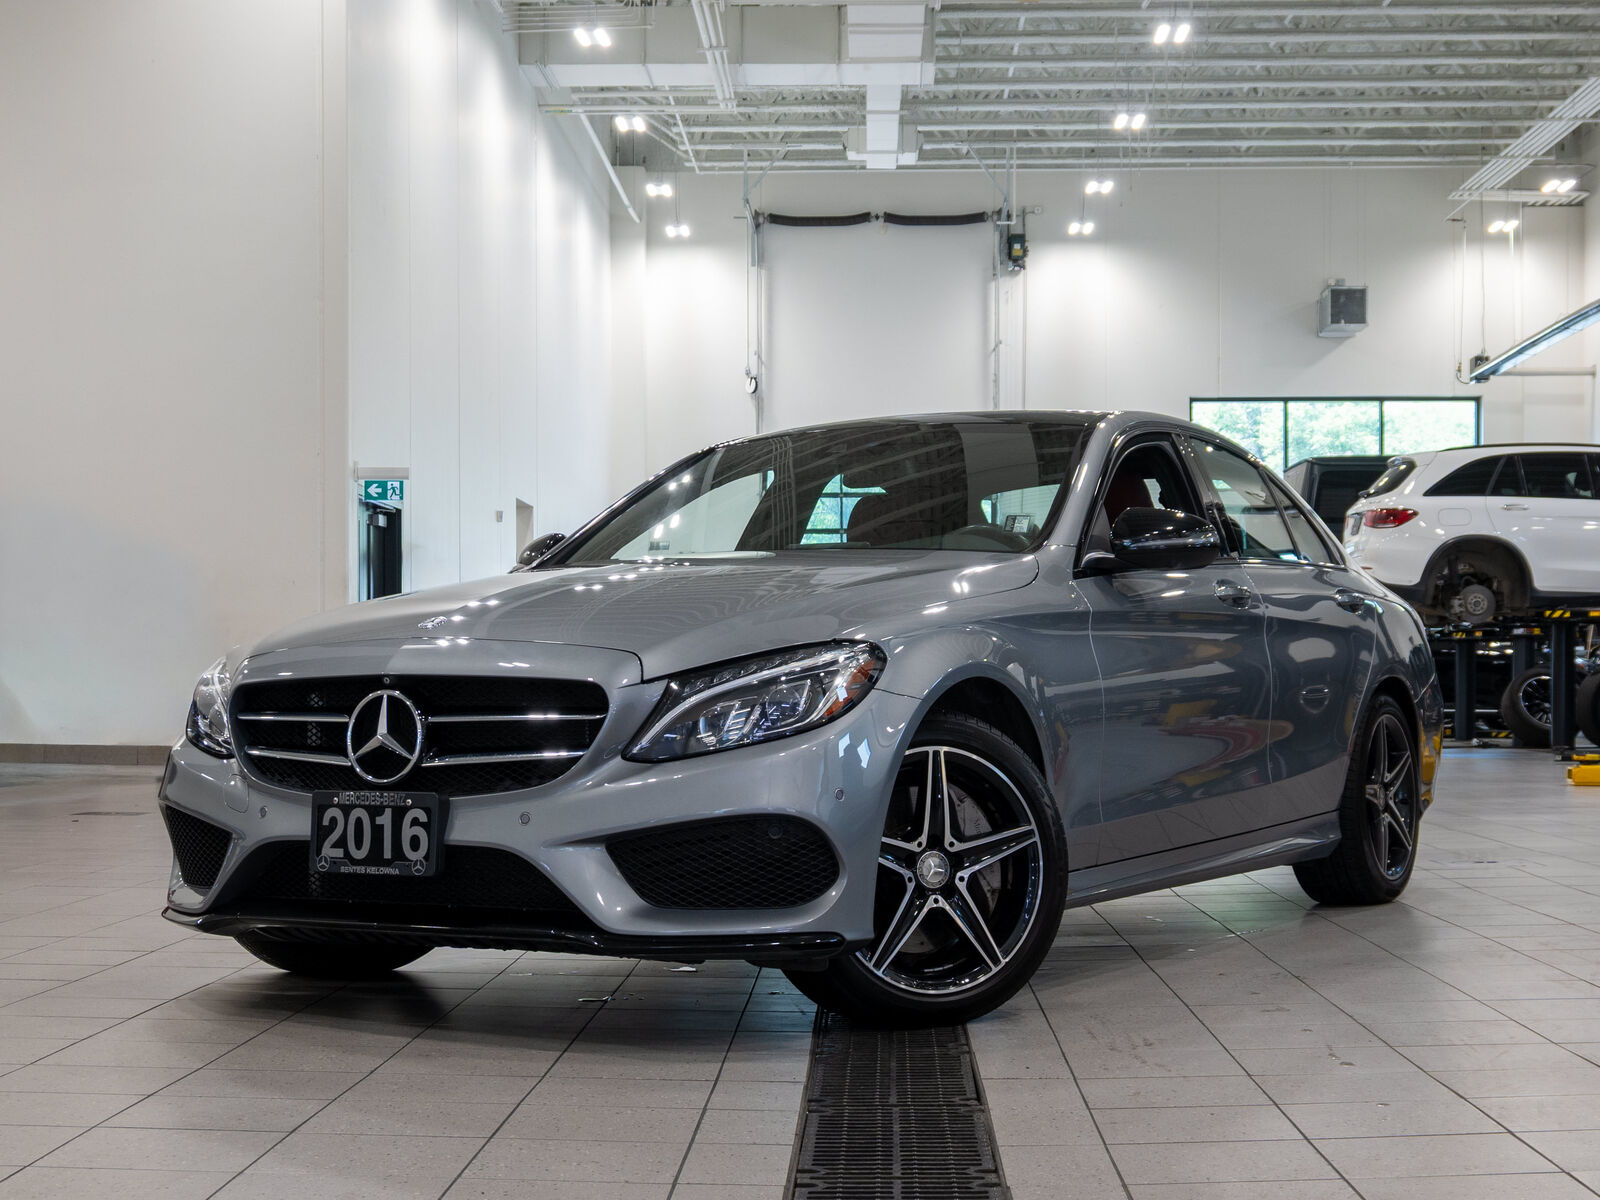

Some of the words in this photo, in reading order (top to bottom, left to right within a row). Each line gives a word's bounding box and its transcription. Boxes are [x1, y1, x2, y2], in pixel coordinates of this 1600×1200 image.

[339, 791, 406, 806] MERCEDES-BENZ
[321, 807, 429, 860] 2016
[366, 867, 400, 875] KELOWNA
